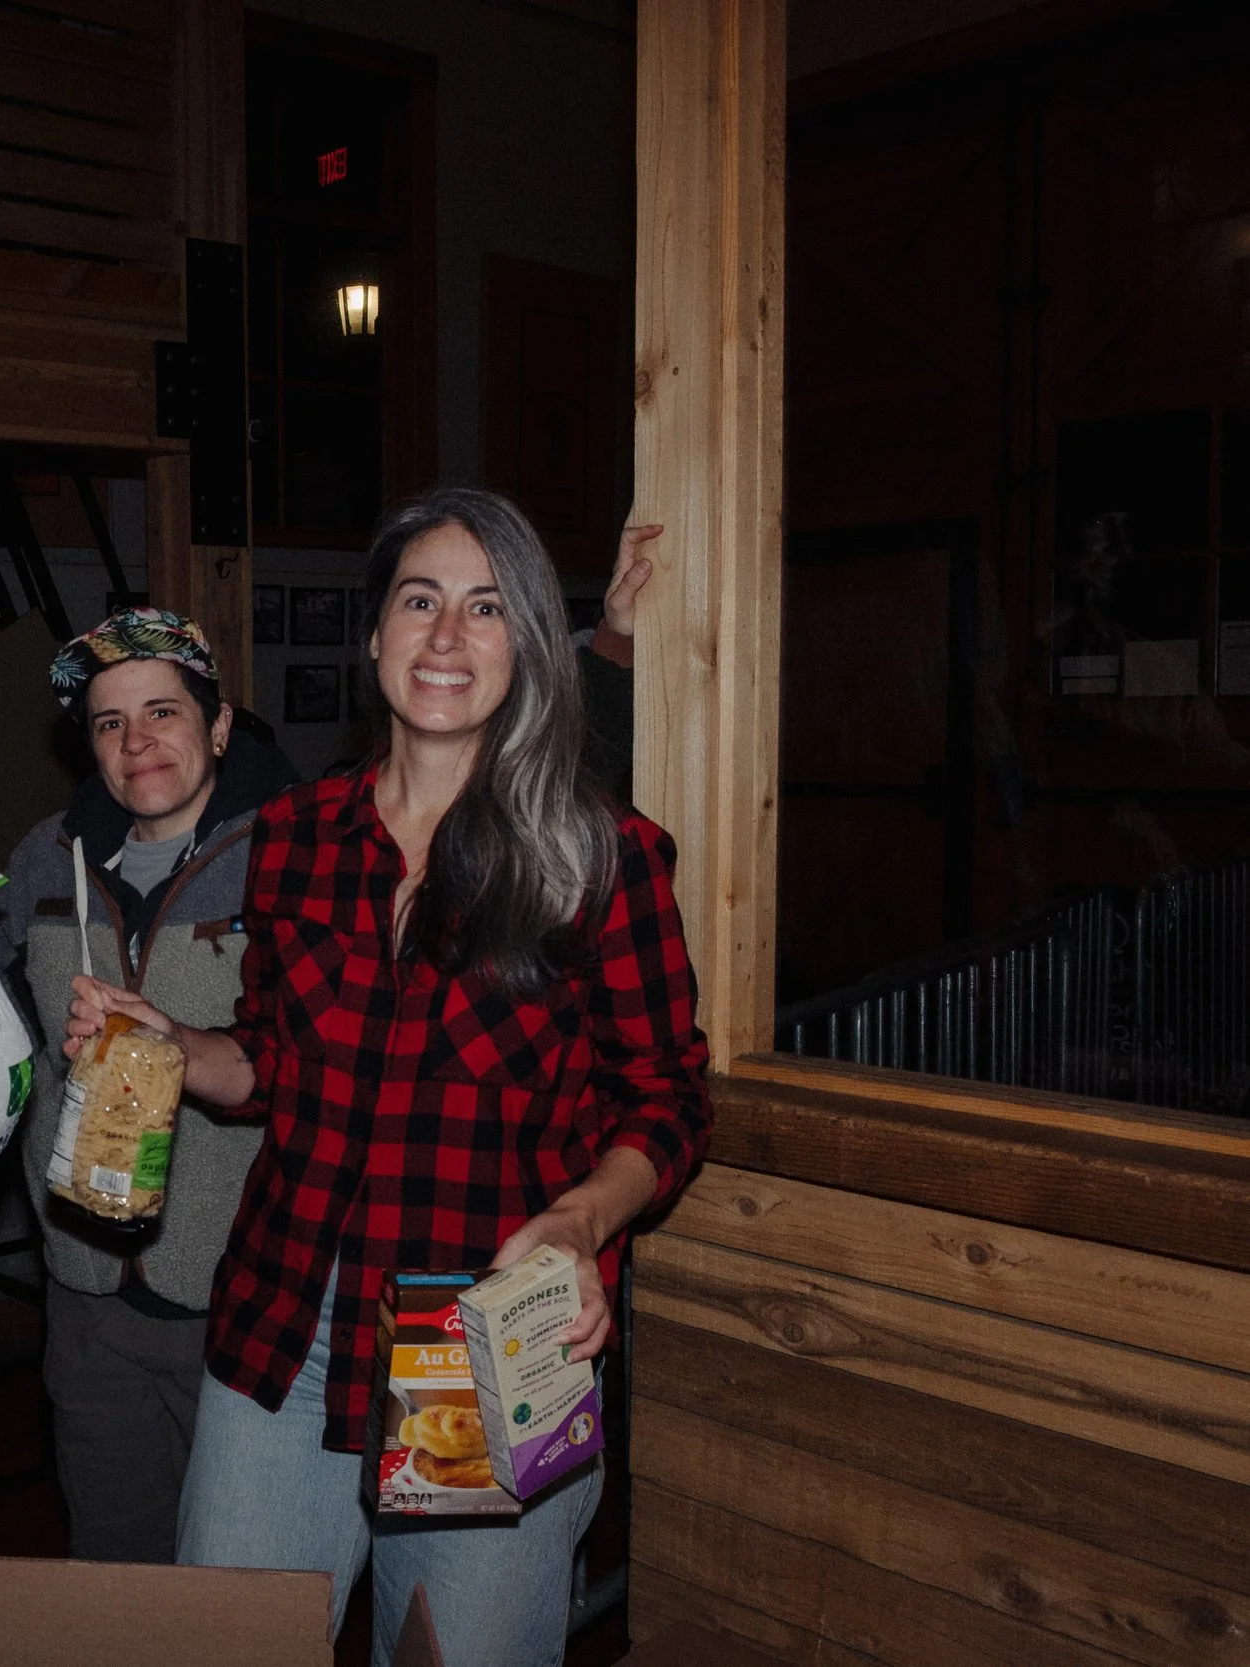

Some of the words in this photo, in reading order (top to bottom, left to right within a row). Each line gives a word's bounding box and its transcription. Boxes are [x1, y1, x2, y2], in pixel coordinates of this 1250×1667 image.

[502, 1284, 569, 1322] GOODNESS
[500, 1313, 526, 1334] STARTS
[537, 1301, 552, 1309] THE
[526, 1316, 573, 1343] YUMMINESS
[414, 1348, 444, 1365] Au
[521, 1361, 556, 1381] ORGANIC
